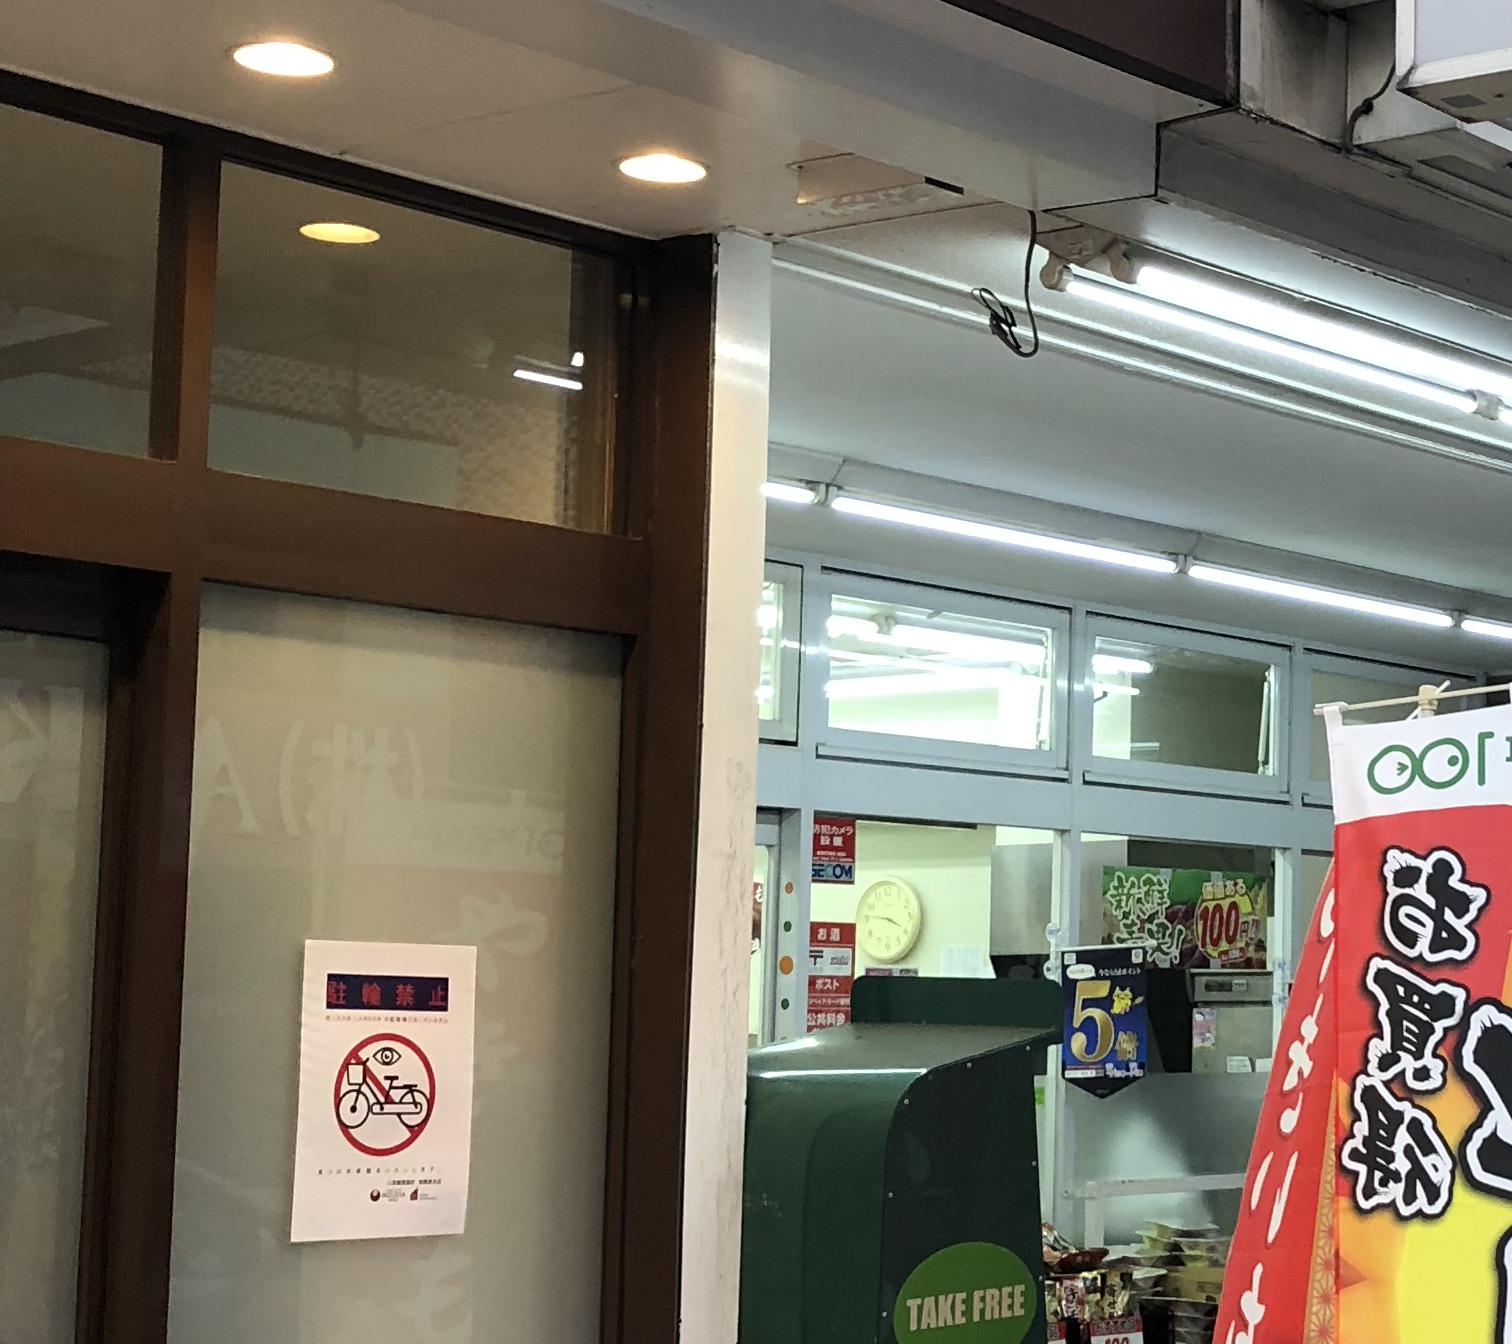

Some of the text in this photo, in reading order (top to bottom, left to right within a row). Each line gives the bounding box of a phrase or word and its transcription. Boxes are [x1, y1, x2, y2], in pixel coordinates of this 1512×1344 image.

[814, 977, 840, 991] ポスト
[906, 1292, 967, 1332] TAKE
[972, 1283, 1026, 1323] FREE
